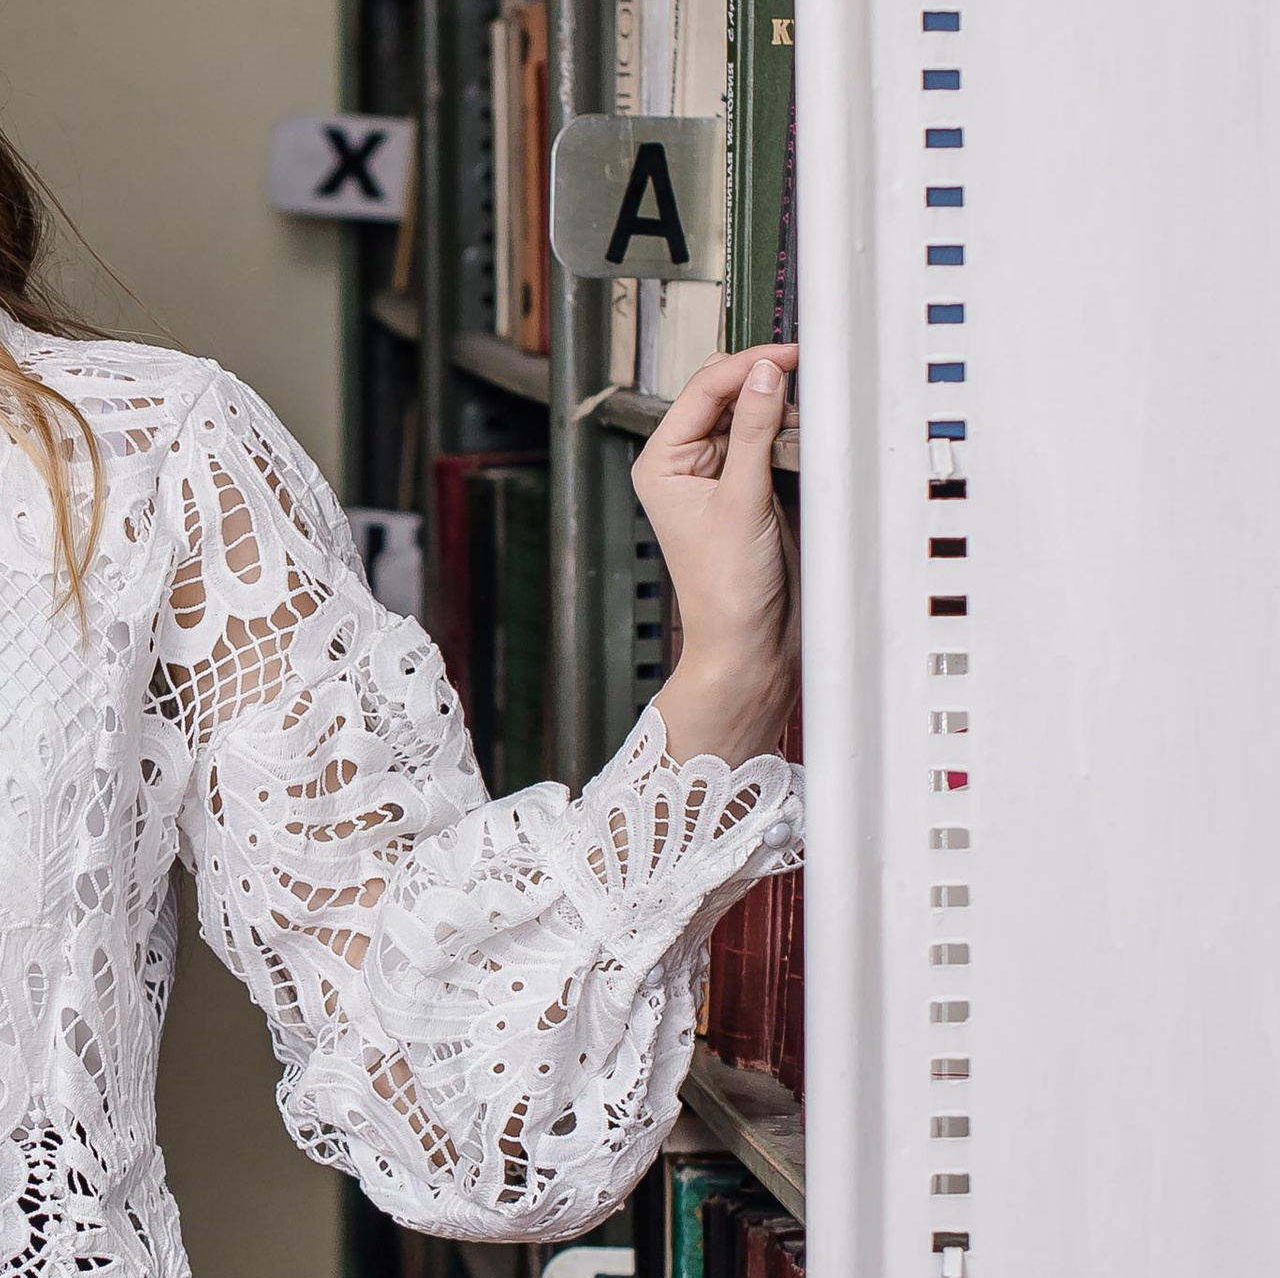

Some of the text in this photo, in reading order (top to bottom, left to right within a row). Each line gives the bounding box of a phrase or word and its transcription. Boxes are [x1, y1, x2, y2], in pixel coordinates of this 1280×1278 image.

[726, 61, 735, 146] ИСТОРИЯ
[316, 124, 388, 202] Х
[604, 142, 690, 264] А
